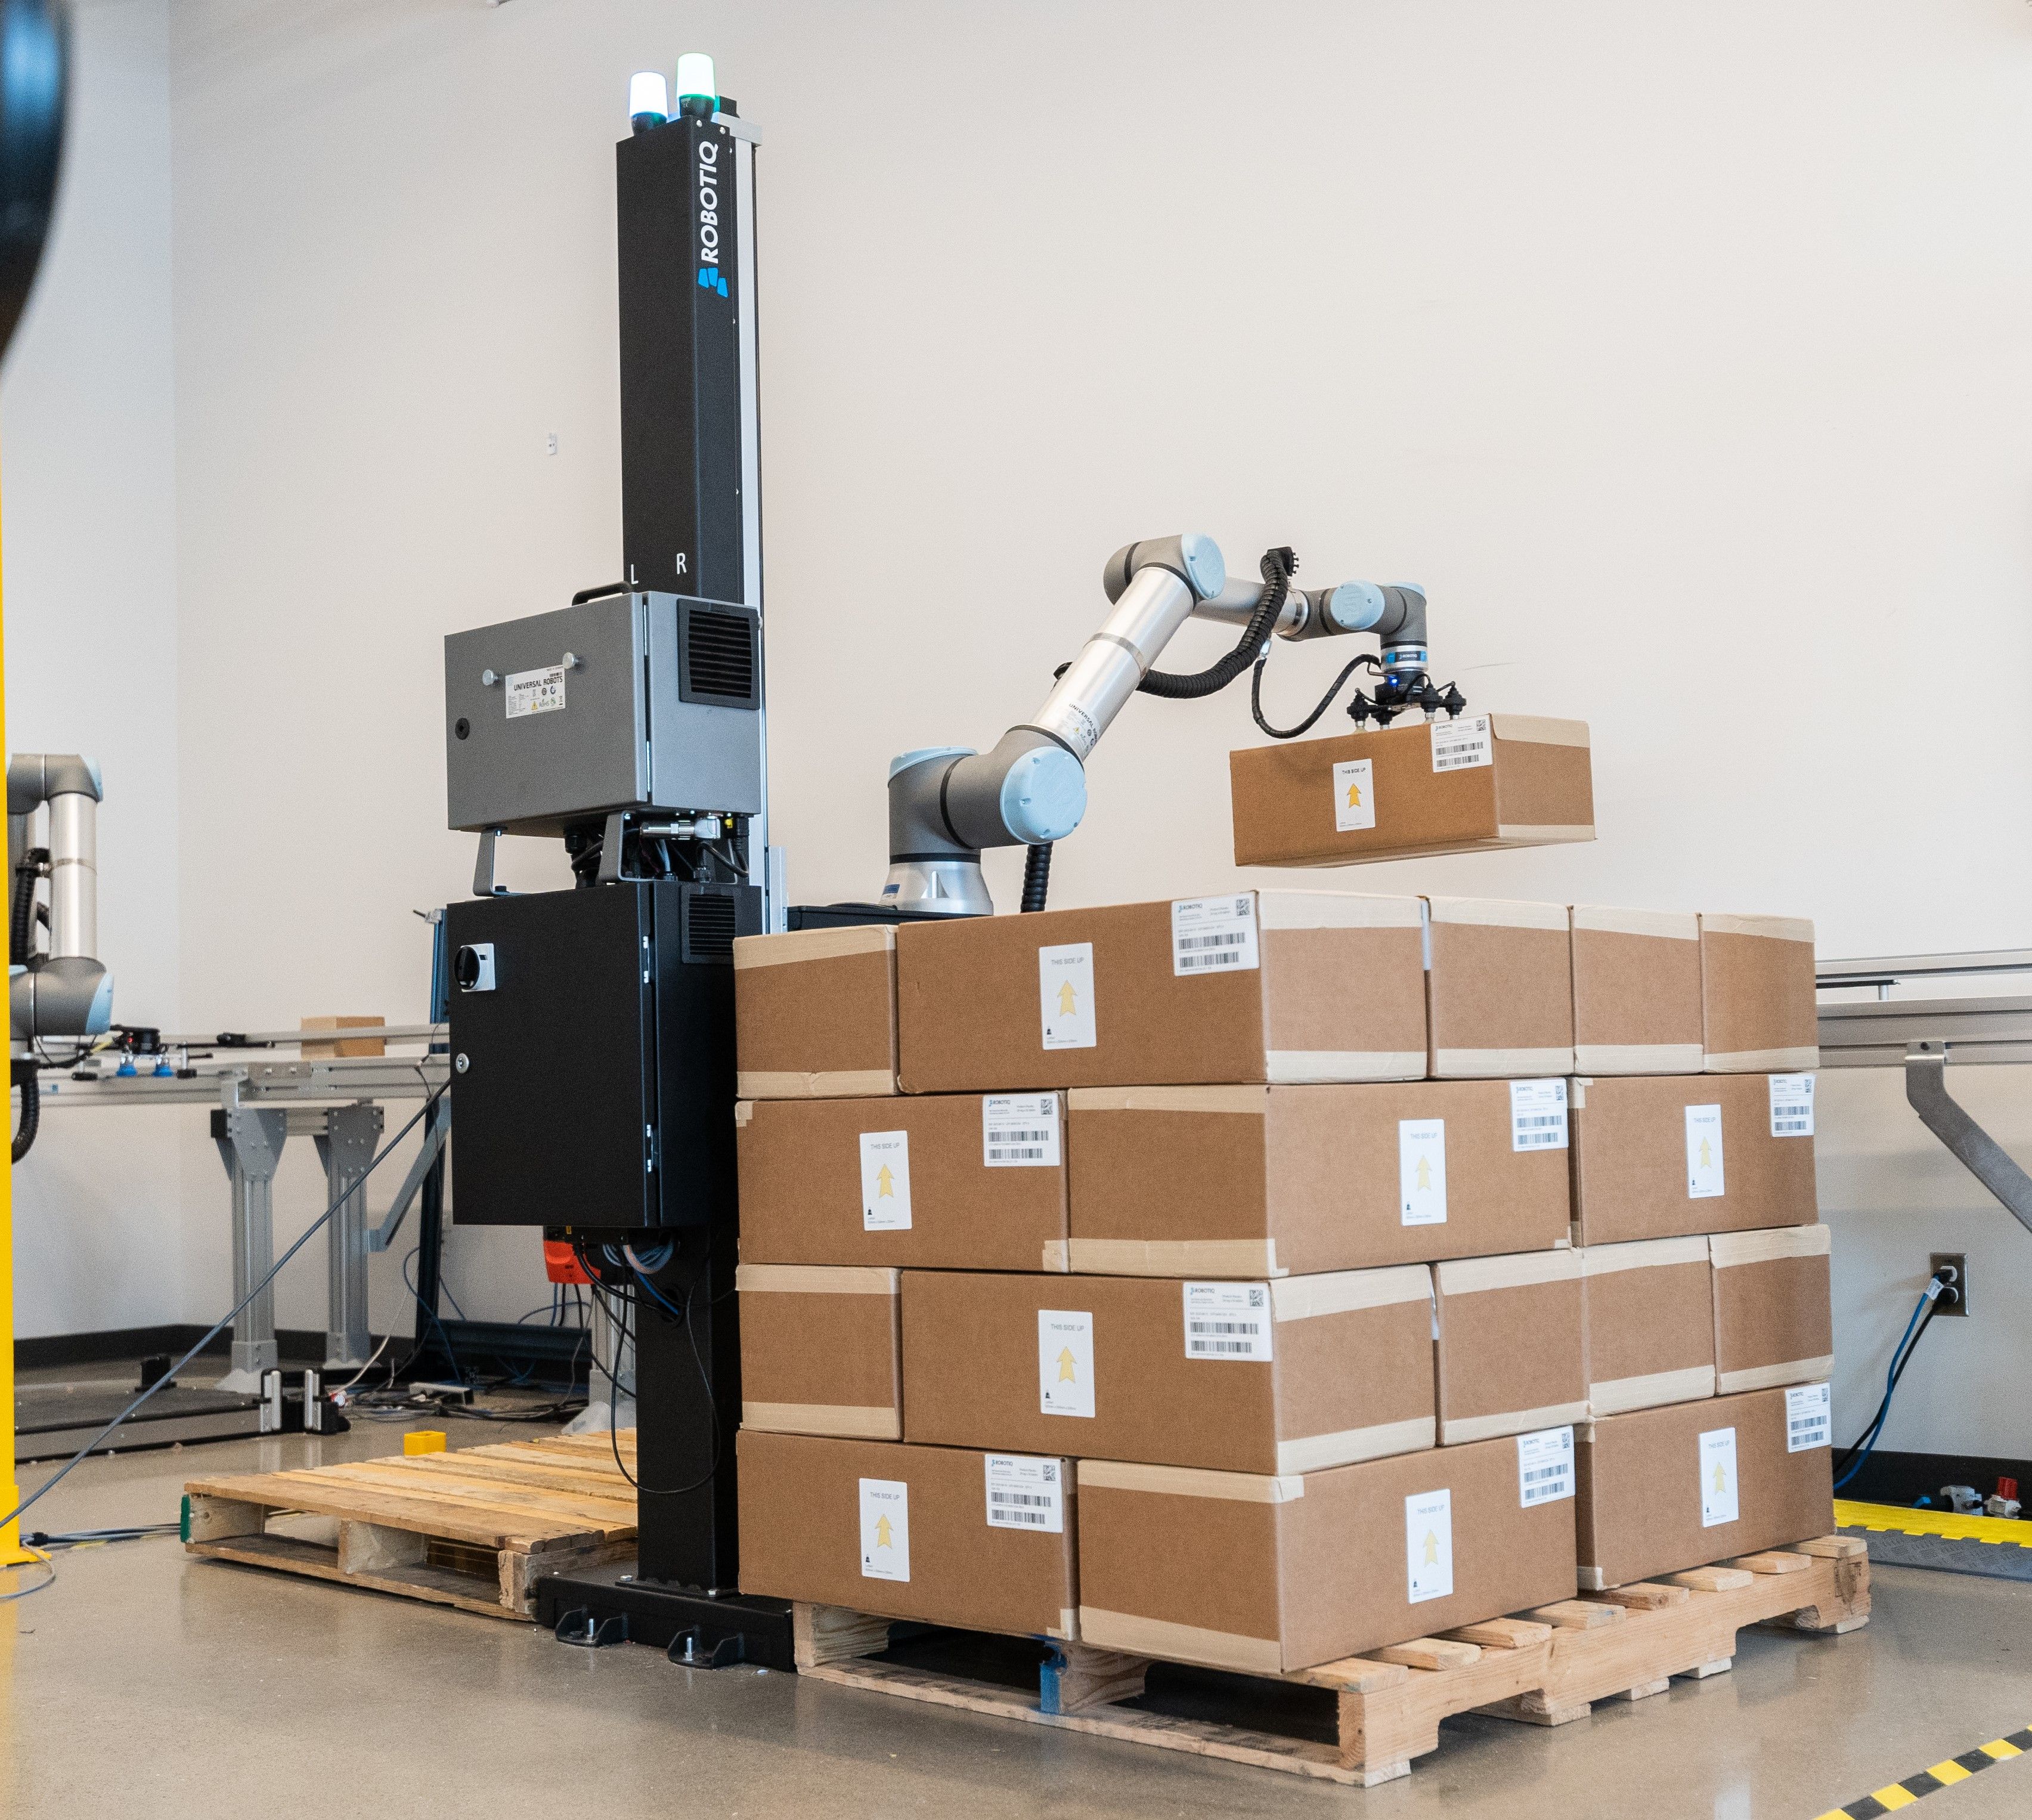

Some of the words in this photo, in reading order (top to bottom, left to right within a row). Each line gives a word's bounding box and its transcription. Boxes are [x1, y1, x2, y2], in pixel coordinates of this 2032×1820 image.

[699, 141, 718, 264] ROBOTIQ
[630, 564, 639, 584] L
[676, 552, 687, 574] R
[513, 680, 541, 691] UNIVERSAL
[543, 676, 563, 685] ROBOTS
[1068, 703, 1094, 728] UNIVERSAL
